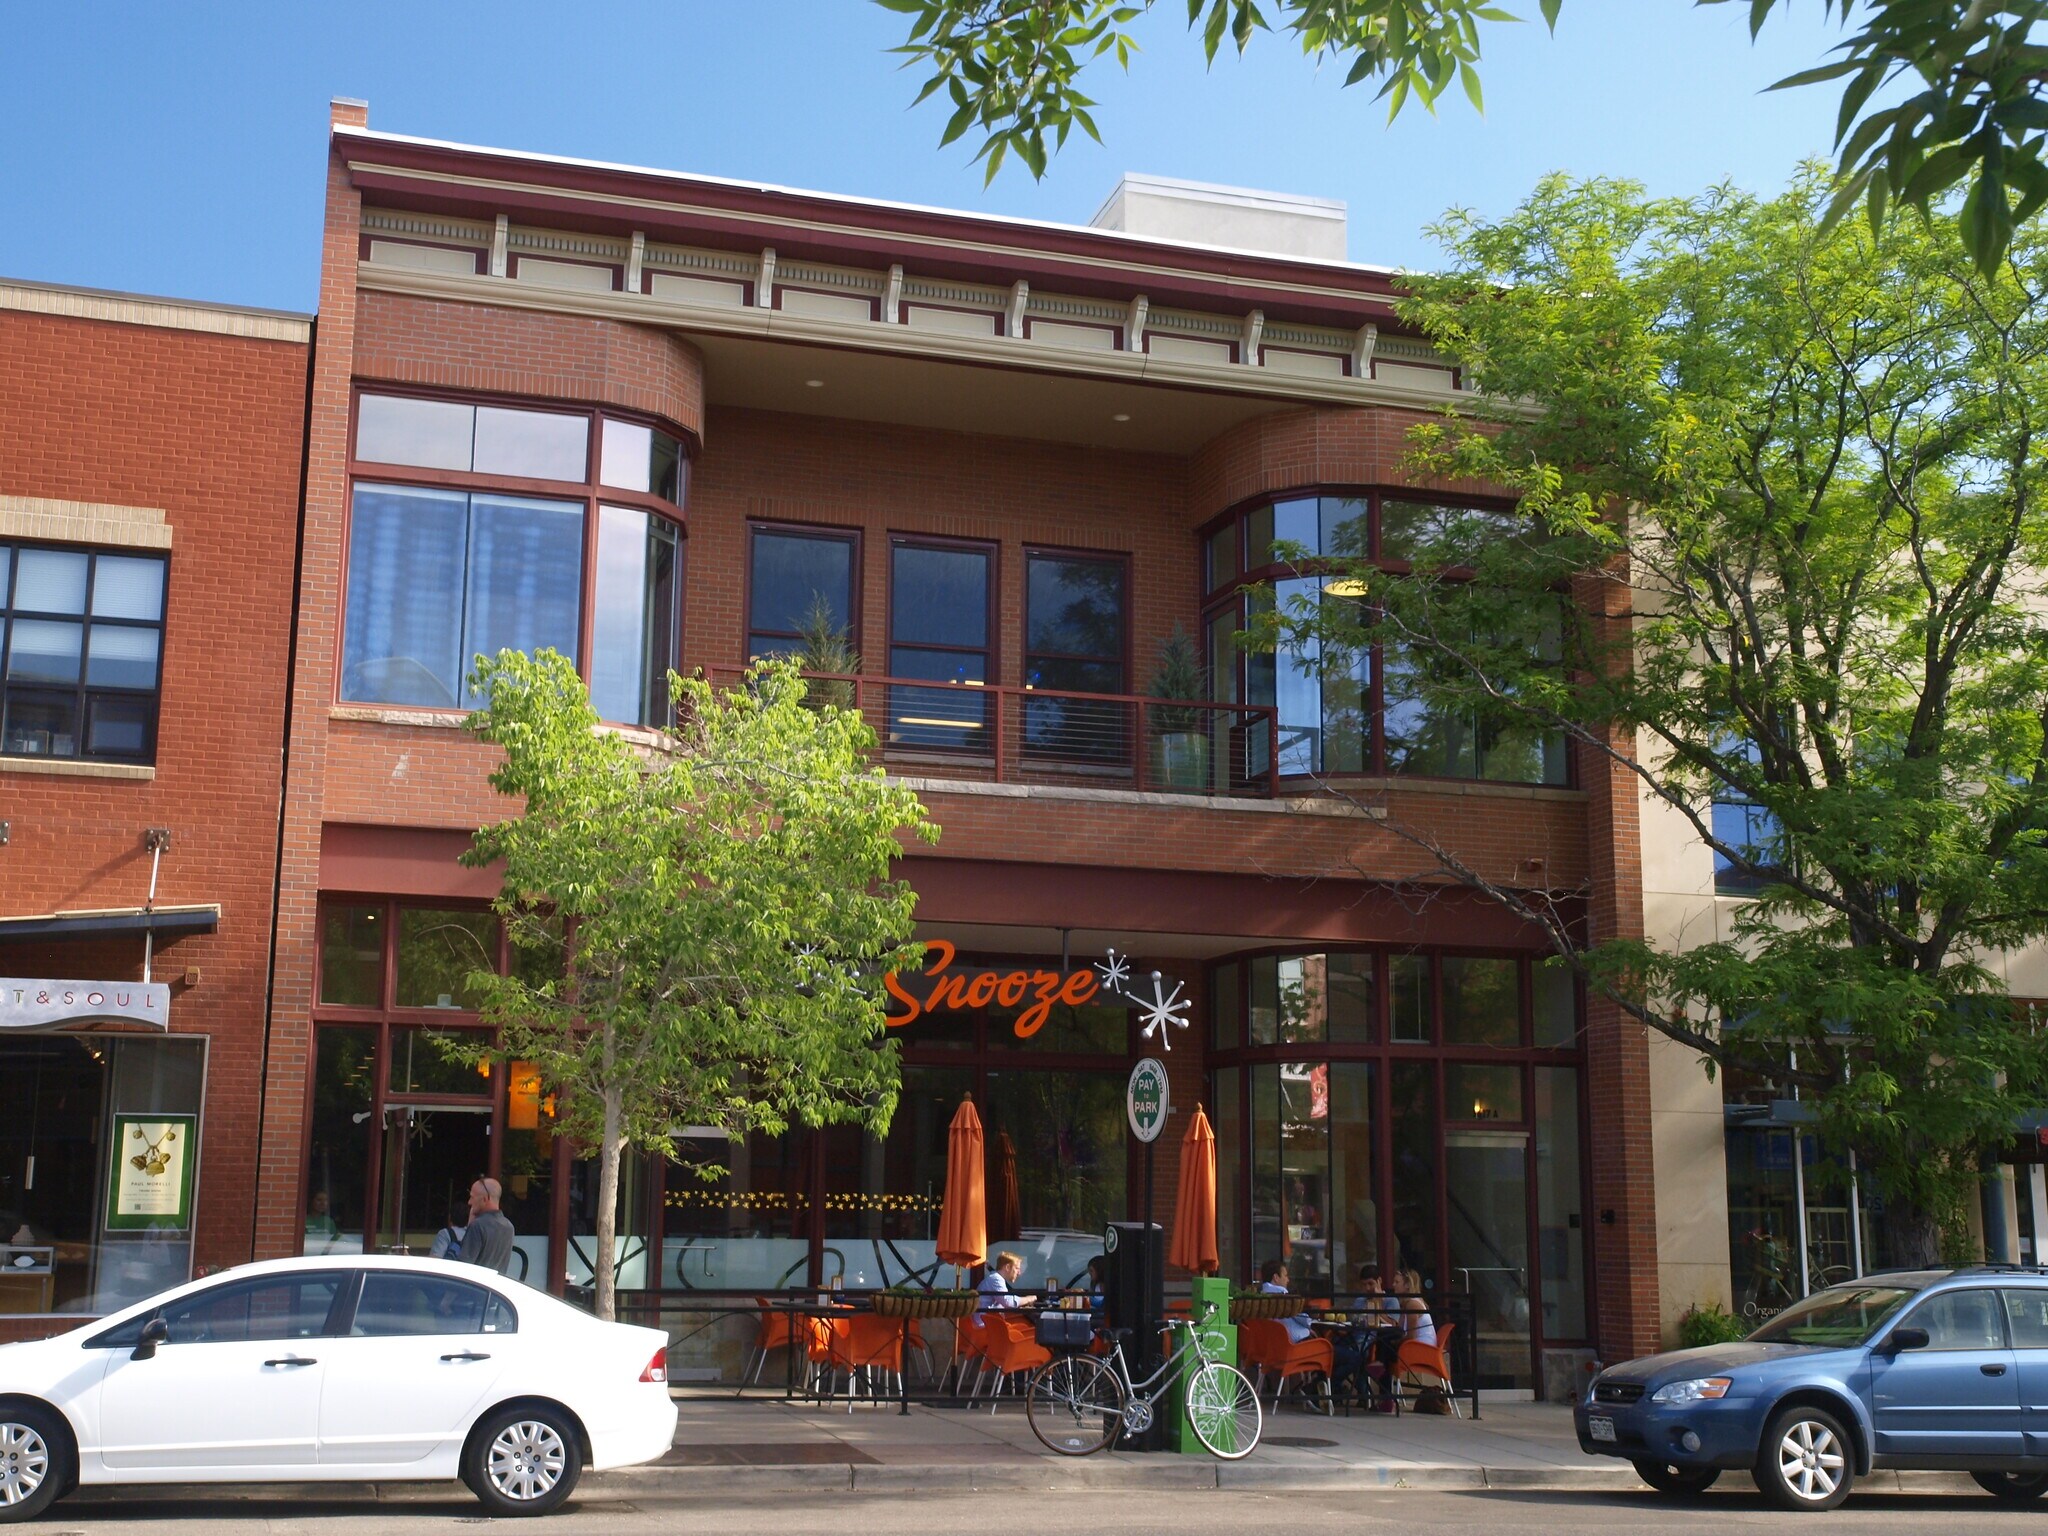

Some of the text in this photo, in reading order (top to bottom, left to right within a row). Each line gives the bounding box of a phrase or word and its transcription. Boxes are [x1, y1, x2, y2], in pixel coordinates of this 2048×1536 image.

[884, 939, 1099, 1038] Snooze
[1138, 1079, 1154, 1091] PAY
[1134, 1102, 1157, 1113] PARK
